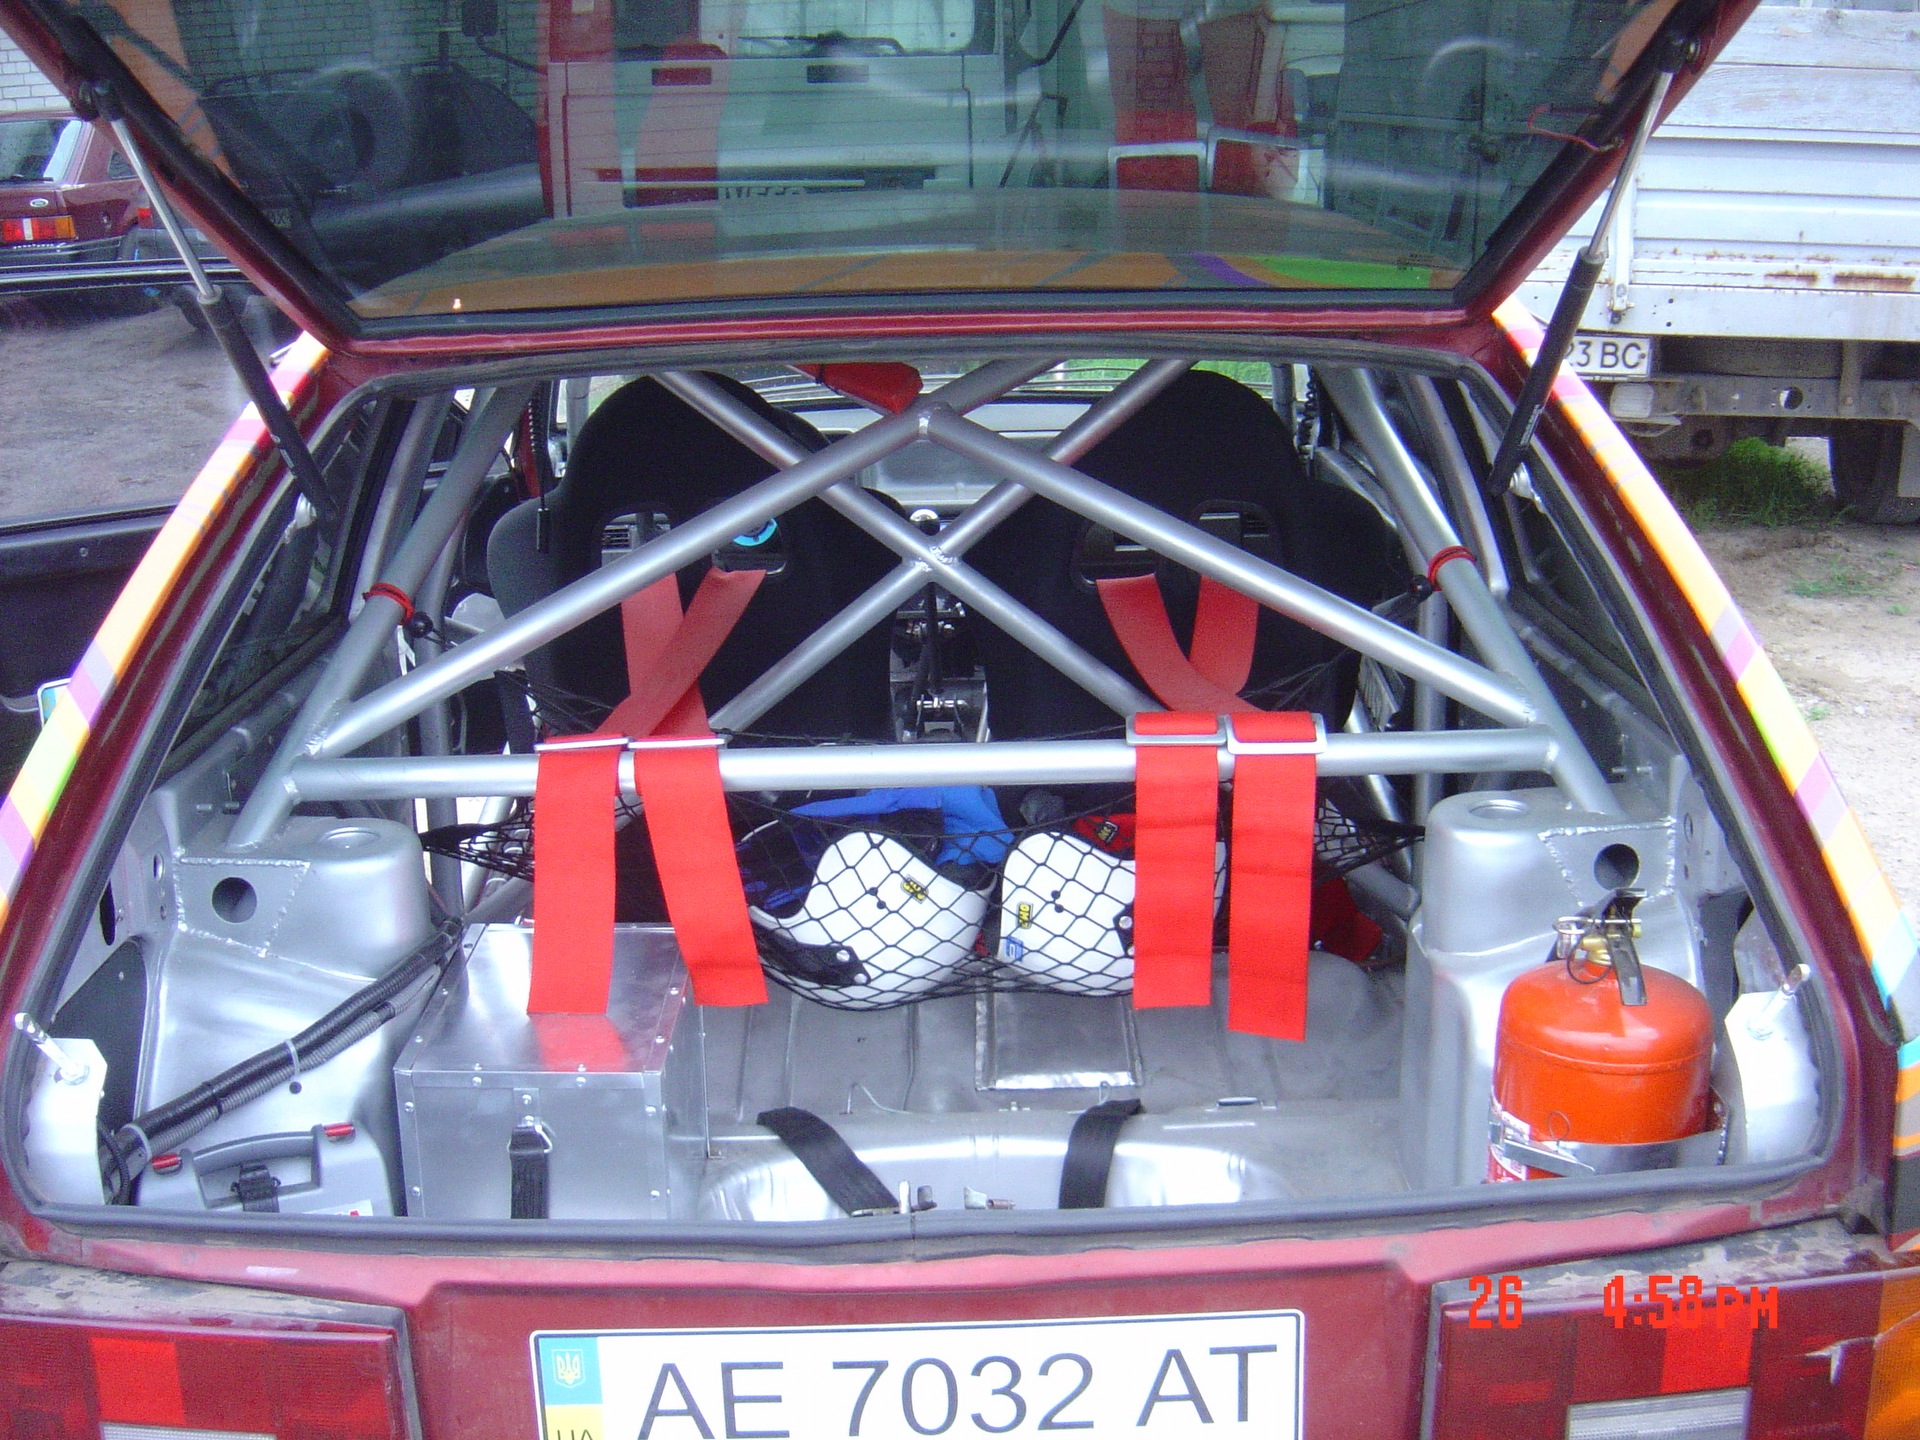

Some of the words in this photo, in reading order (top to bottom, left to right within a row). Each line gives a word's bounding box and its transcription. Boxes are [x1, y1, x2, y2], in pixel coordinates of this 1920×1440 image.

[1600, 341, 1642, 369] BC
[637, 1361, 790, 1440] AE
[832, 1352, 1094, 1437] 7032
[1136, 1344, 1277, 1427] AT
